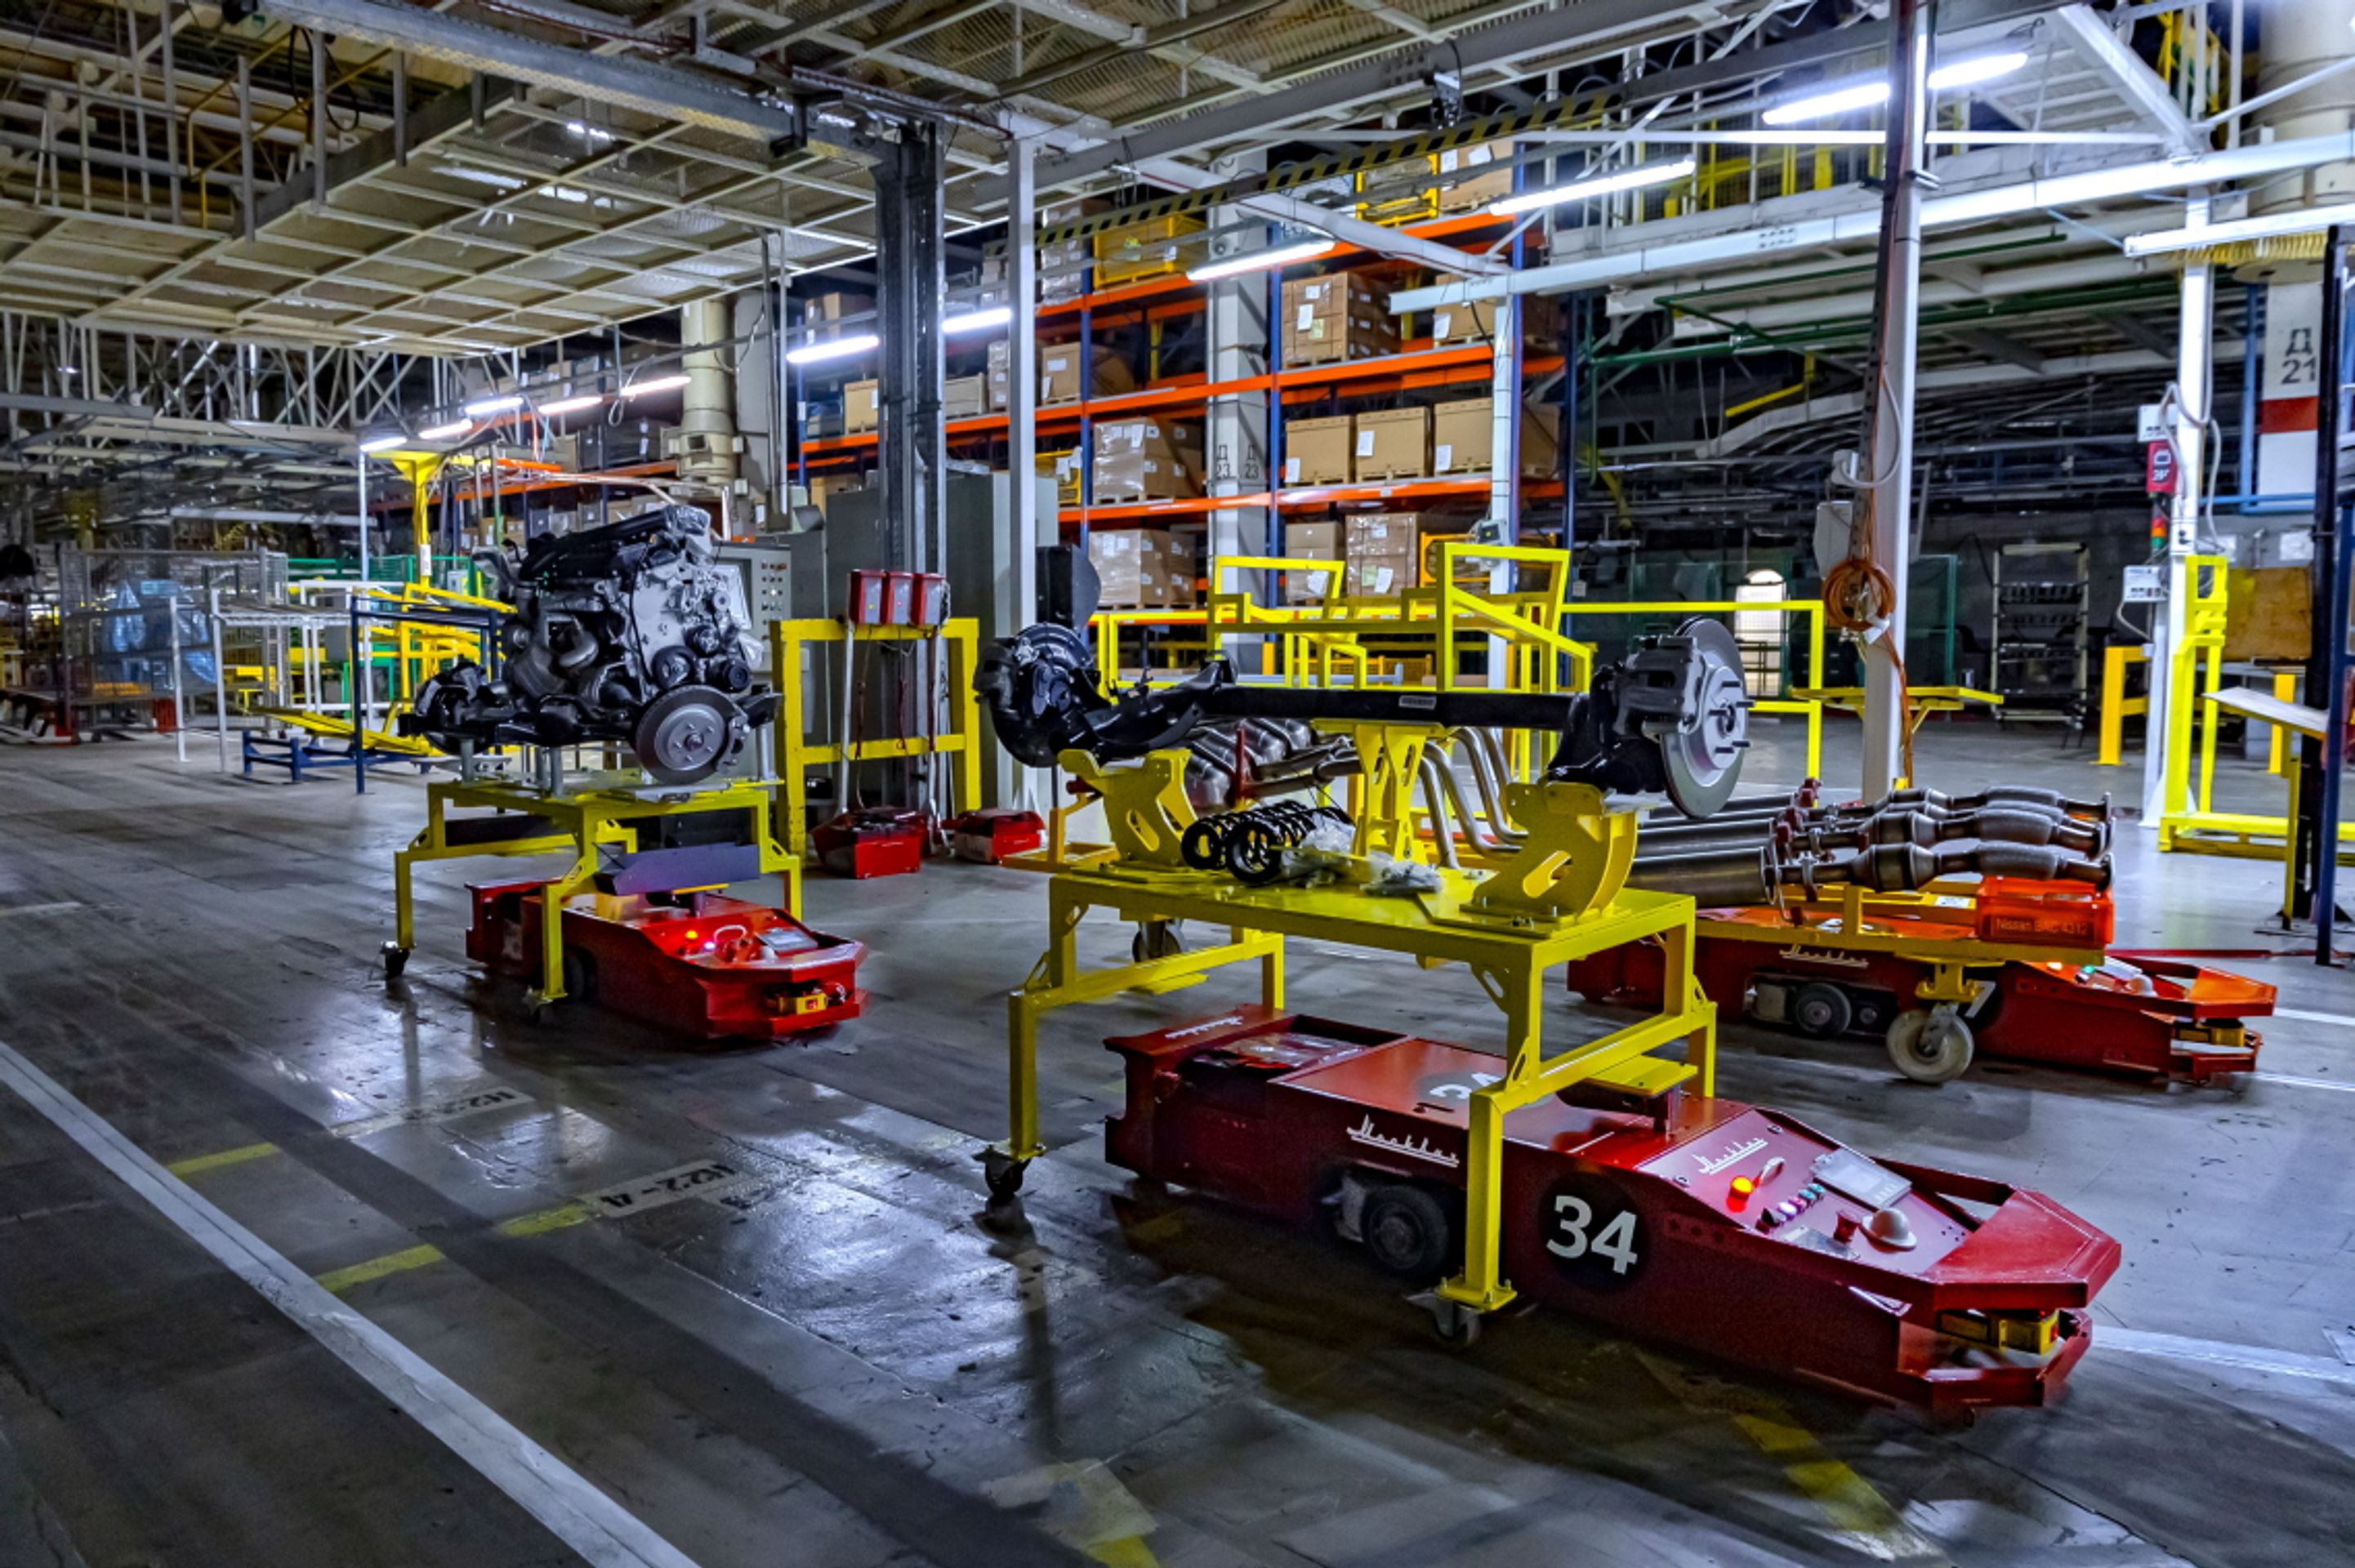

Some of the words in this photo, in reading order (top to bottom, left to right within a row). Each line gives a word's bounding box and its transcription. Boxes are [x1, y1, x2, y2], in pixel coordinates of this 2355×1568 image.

[2285, 327, 2313, 356] Д
[2281, 358, 2316, 384] 21
[1545, 1195, 1639, 1274] 34
